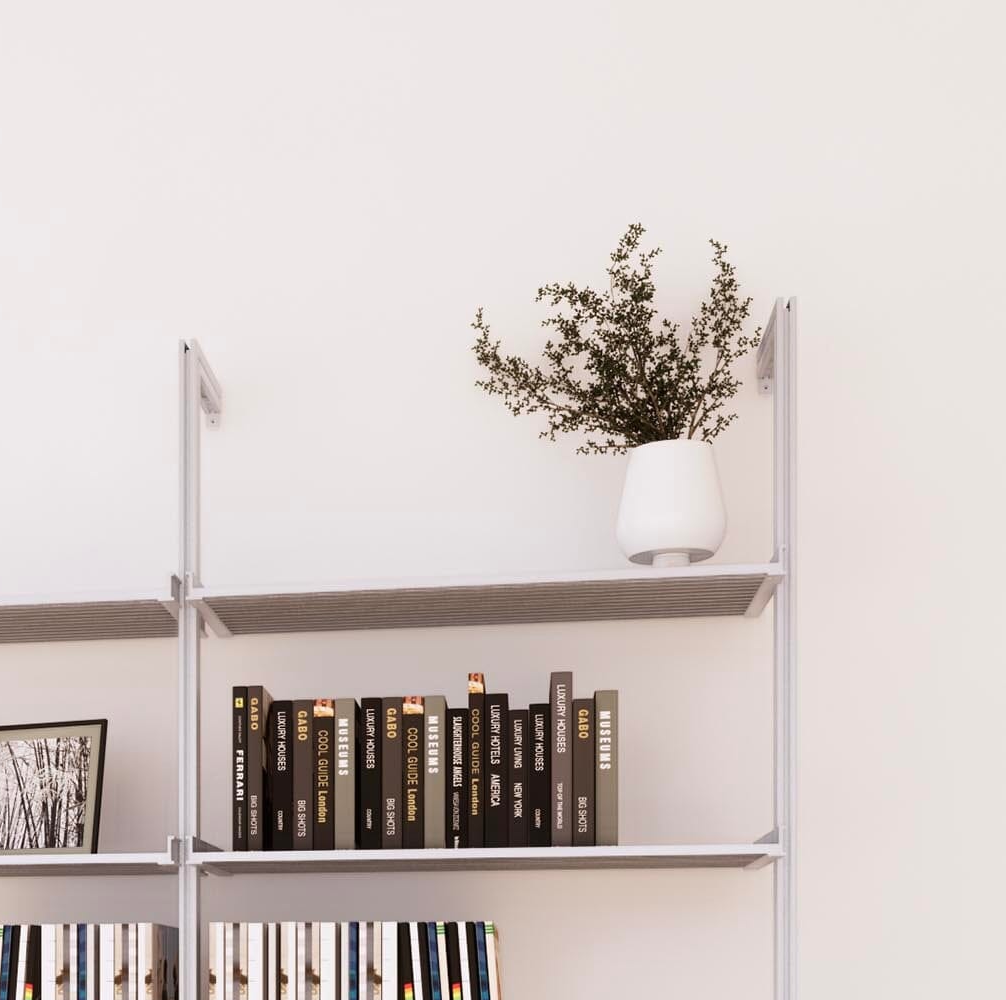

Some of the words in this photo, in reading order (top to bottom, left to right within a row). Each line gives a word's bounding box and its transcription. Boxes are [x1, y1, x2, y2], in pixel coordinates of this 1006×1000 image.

[250, 697, 258, 731] GABO
[556, 684, 565, 717] LUXURY
[277, 711, 286, 738] LUXURY
[298, 711, 307, 741] GABO
[366, 708, 375, 736] LUXURY
[387, 708, 397, 739] GABO
[471, 709, 480, 738] COOL
[491, 705, 500, 734] LUXURY
[514, 719, 522, 746] LUXURY
[535, 714, 544, 741] LUXURY
[578, 709, 589, 739] GABO
[318, 730, 328, 756] COOL
[338, 718, 349, 776] MUSEUMS
[407, 727, 418, 753] COOL
[428, 716, 439, 774] MUSEUMS
[491, 736, 500, 765] HOTELS
[556, 719, 565, 753] HOUSES
[599, 711, 610, 770] MUSEUMS
[277, 740, 286, 771] HOUSES
[366, 738, 375, 769] HOUSES
[471, 741, 480, 774] GUIDE
[514, 747, 522, 768] LIVING
[535, 742, 544, 771] HOUSES
[236, 750, 244, 801] FERRARI
[318, 758, 328, 787] GUIDE
[407, 757, 418, 784] GUIDE
[453, 766, 462, 787] ANGELS
[386, 798, 395, 810] BIG
[471, 778, 480, 816] London
[491, 774, 500, 807] AMERICA
[514, 783, 522, 796] NEW
[578, 796, 587, 808] BIG
[298, 800, 306, 812] BIG
[318, 790, 328, 823] London
[407, 788, 418, 821] London
[514, 798, 522, 818] YORK
[250, 810, 258, 836] SHOTS
[298, 813, 306, 837] SHOTS
[386, 811, 395, 836] SHOTS
[578, 809, 587, 833] SHOTS
